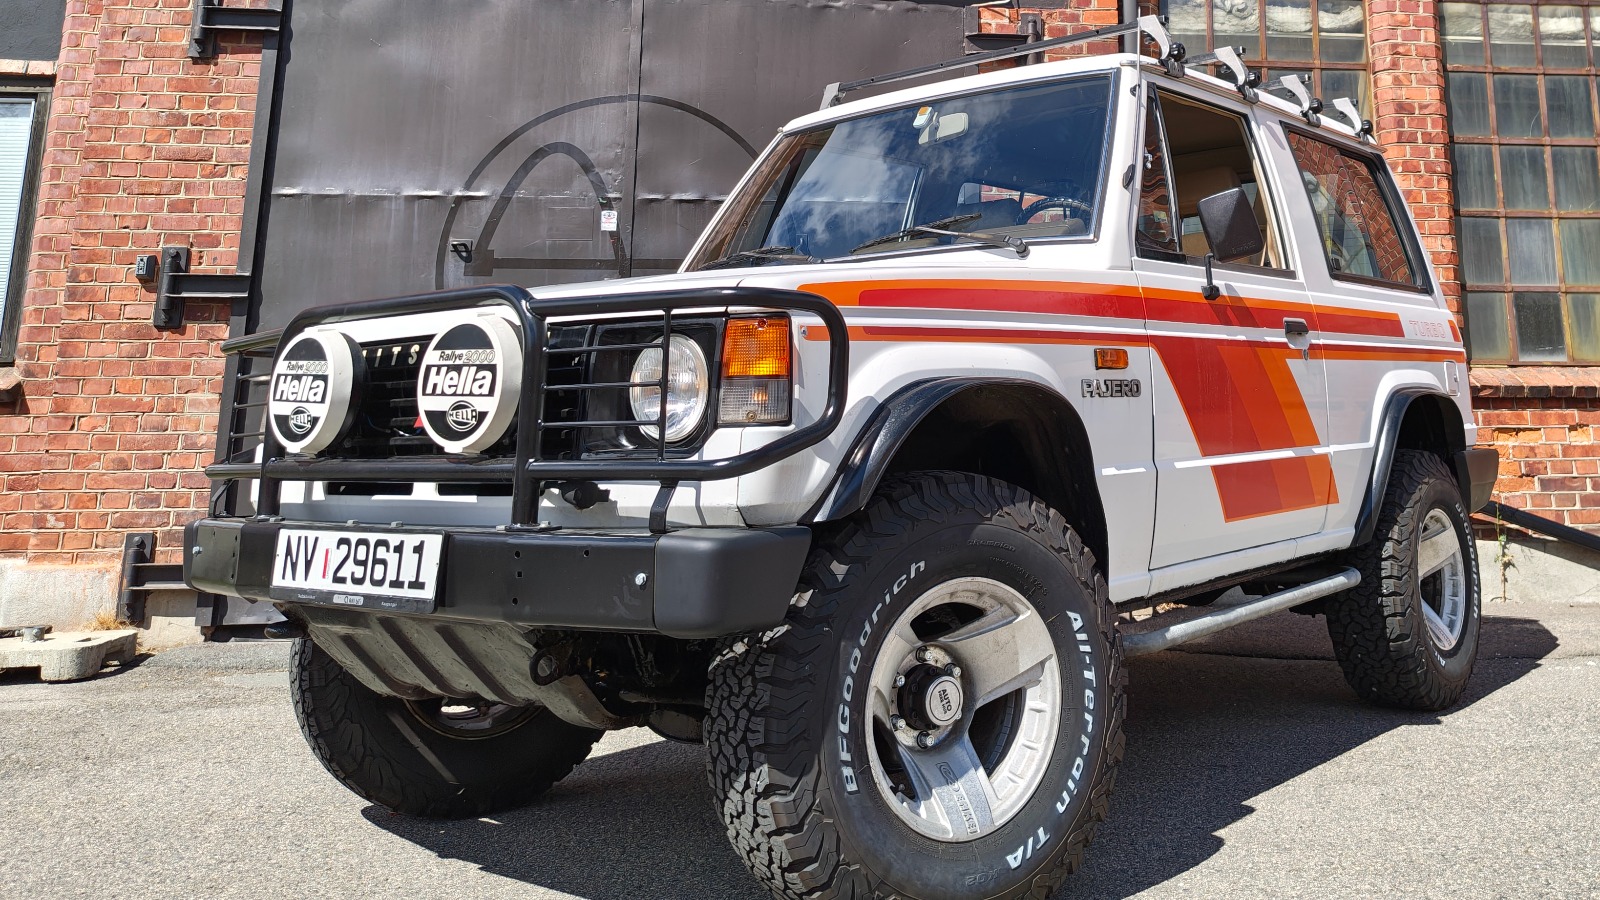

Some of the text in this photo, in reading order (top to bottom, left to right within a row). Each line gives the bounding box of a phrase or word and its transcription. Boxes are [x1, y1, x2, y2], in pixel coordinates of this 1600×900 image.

[1408, 320, 1446, 338] TURBO
[286, 361, 328, 373] Rallye 2000
[362, 344, 420, 367] ITS
[439, 350, 496, 363] Rallye 2000
[275, 375, 325, 402] Hella
[425, 366, 493, 395] Hella
[1081, 379, 1141, 398] PAJERO
[290, 413, 313, 428] HELLA
[448, 408, 478, 423] HELLA
[281, 534, 426, 590] NV 29611
[838, 559, 927, 795] BFGoodrich
[940, 688, 953, 712] AUTO
[1005, 610, 1098, 871] All-Terrain T/A
